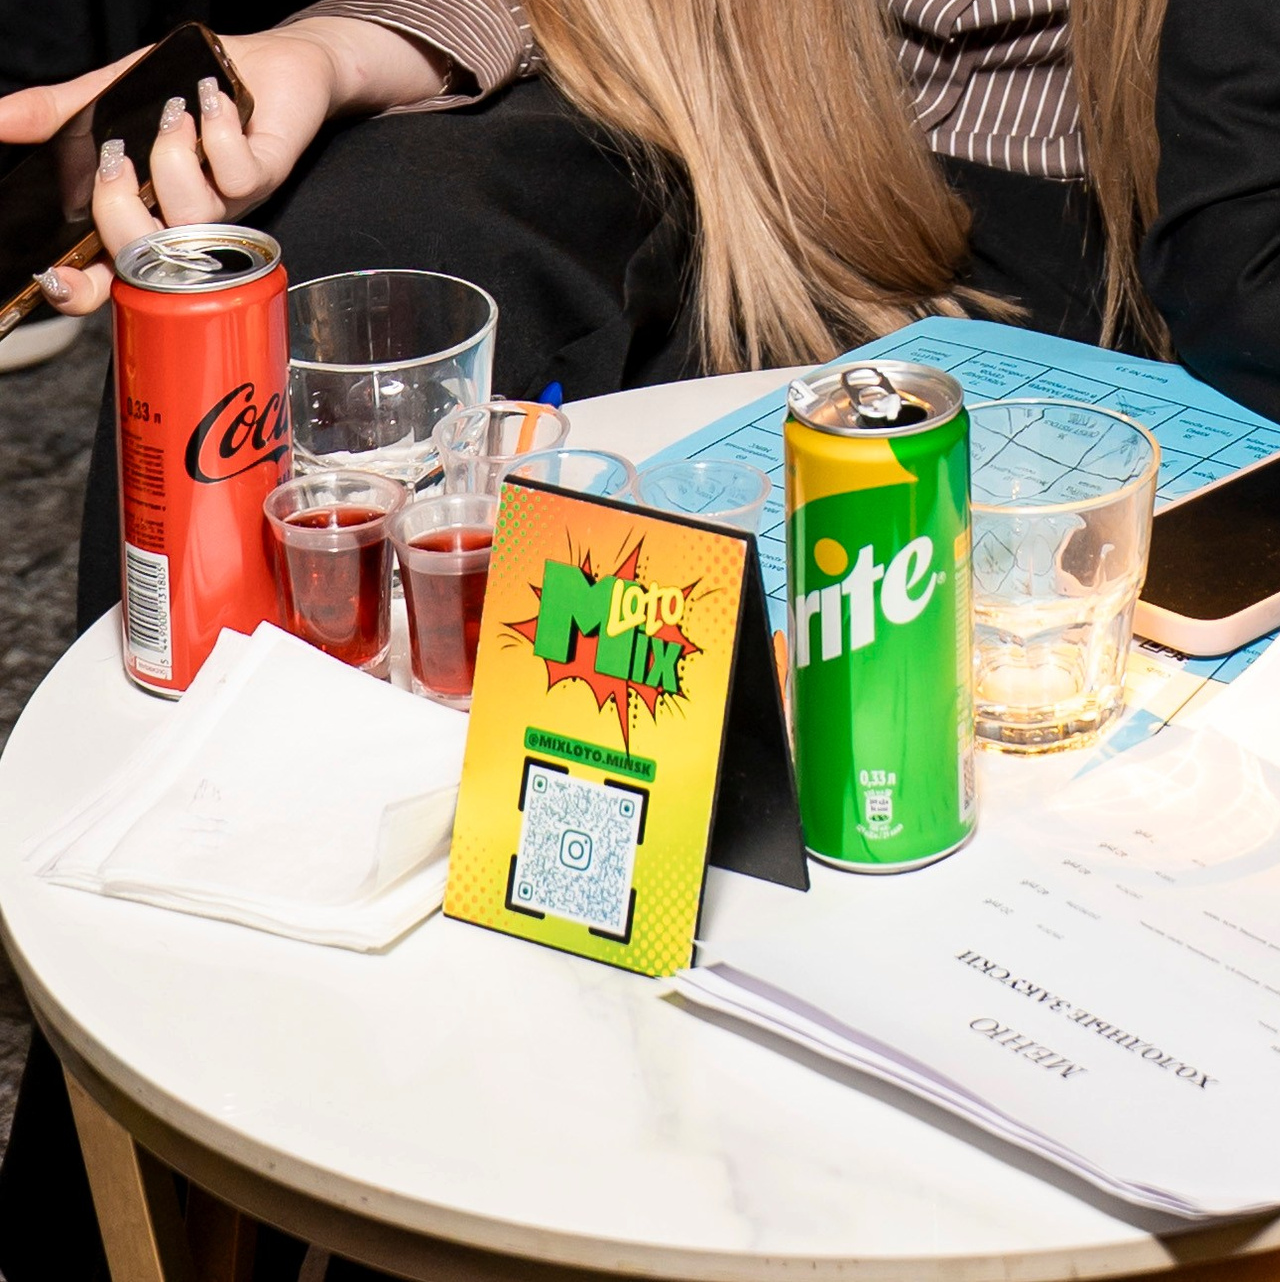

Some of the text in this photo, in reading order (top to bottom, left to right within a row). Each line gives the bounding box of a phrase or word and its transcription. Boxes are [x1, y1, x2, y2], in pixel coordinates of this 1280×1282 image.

[1185, 427, 1210, 437] КИНО
[1204, 426, 1233, 436] Группа
[795, 536, 938, 669] rite
[528, 733, 652, 777] @MIXLOTO.MINSK
[860, 770, 886, 787] 0,33
[956, 948, 1072, 1011] ЗАКУСКИ
[969, 1017, 1087, 1080] МЕНЮ
[1066, 1010, 1218, 1090] ХОЛОДНЫЕ
